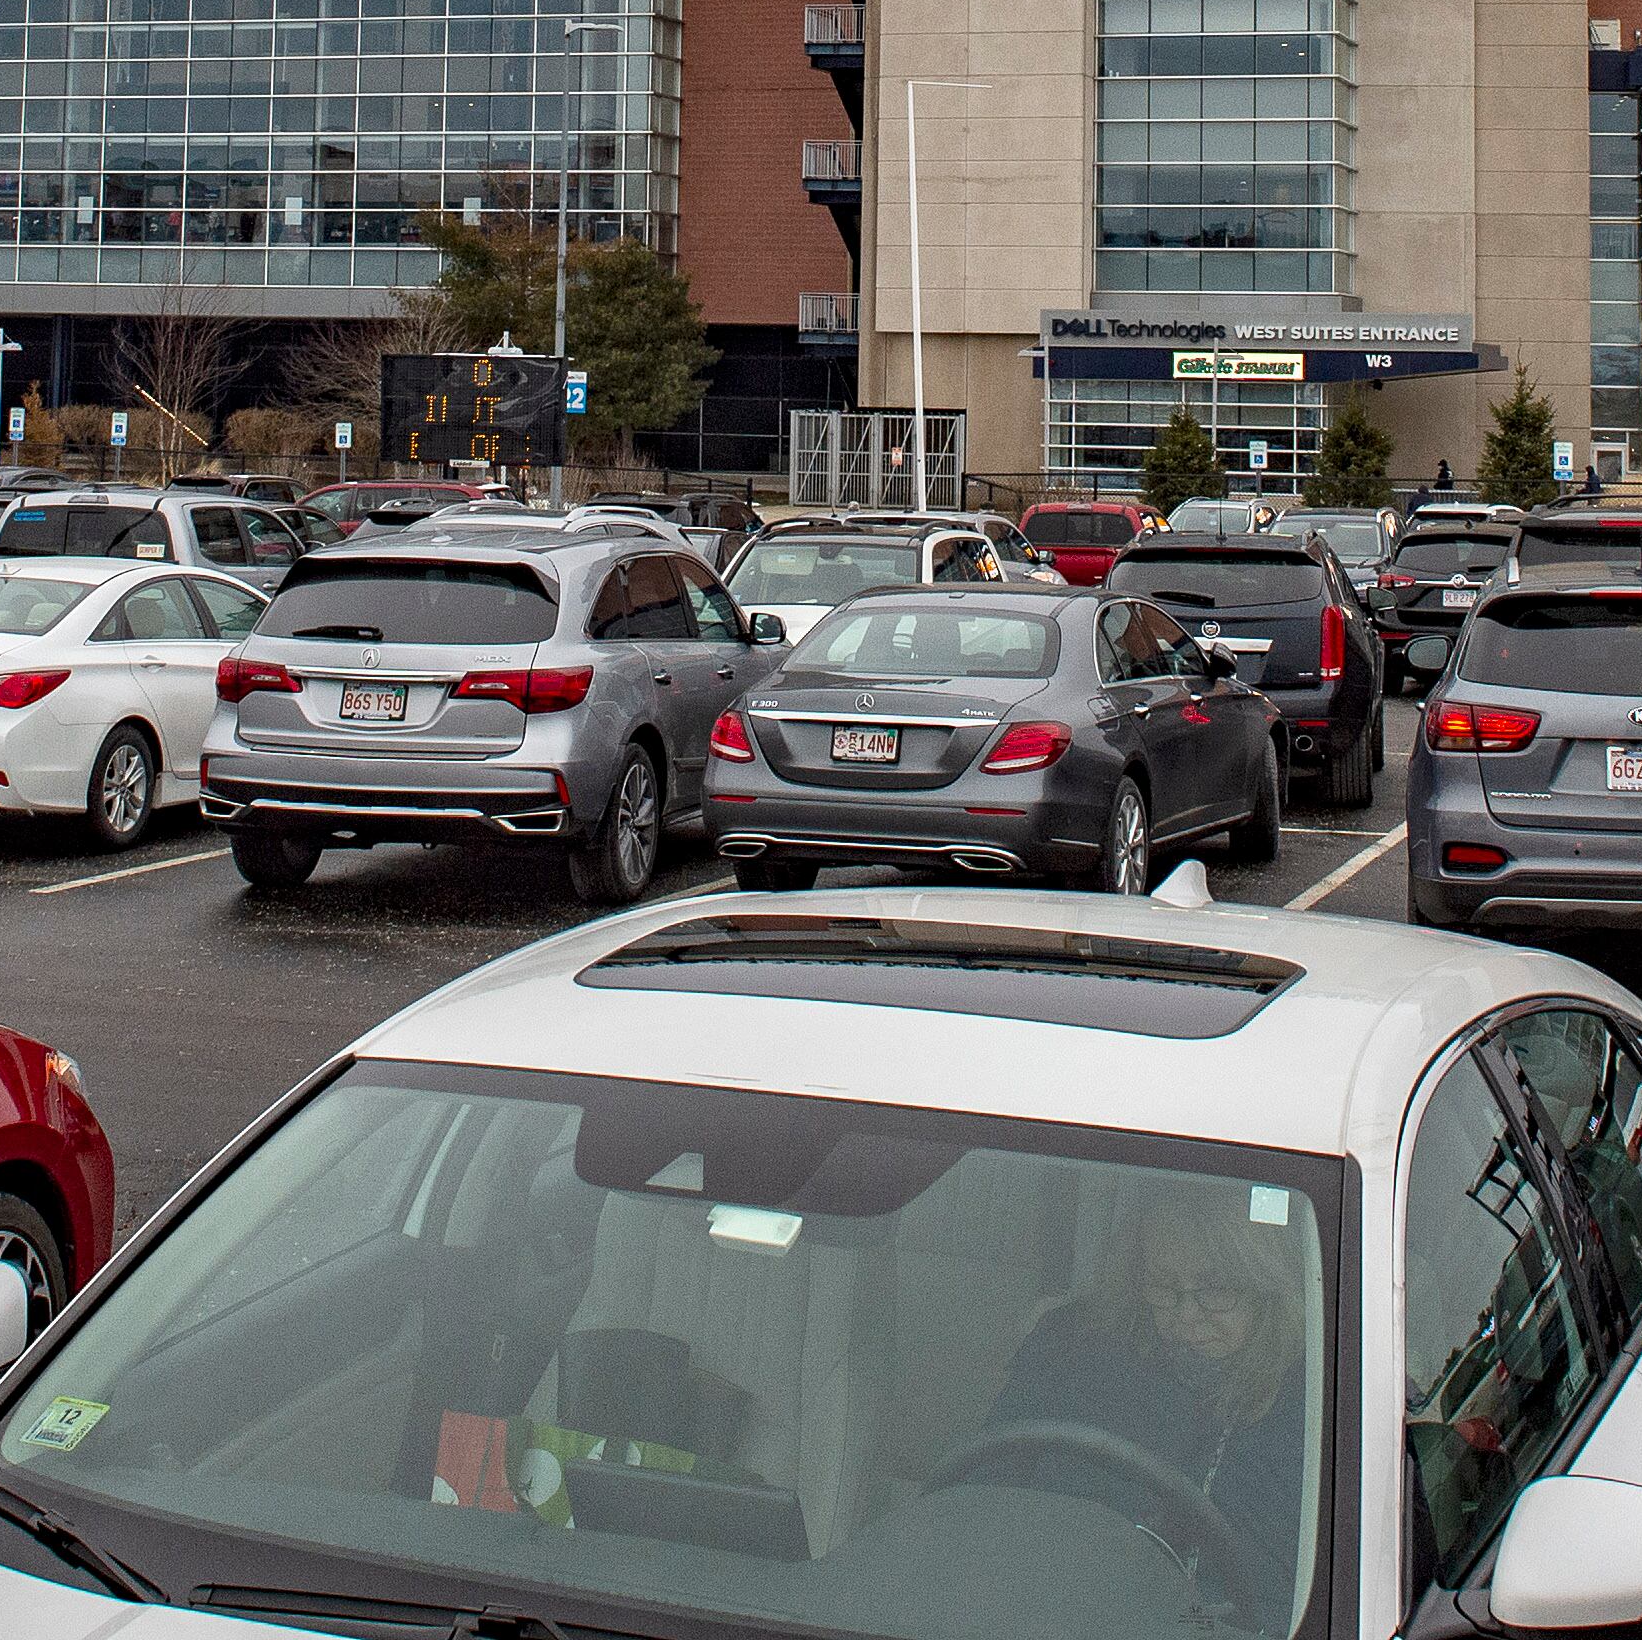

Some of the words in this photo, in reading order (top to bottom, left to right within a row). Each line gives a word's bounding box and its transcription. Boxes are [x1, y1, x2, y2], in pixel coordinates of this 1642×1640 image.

[1051, 318, 1107, 337] DELL
[1107, 318, 1226, 343] Technologies
[1234, 325, 1286, 339] WEST
[1290, 325, 1354, 340] SUITES
[1358, 327, 1459, 342] ENTRANCE
[1365, 354, 1393, 368] W3
[474, 655, 511, 664] MDX
[375, 695, 402, 711] Y50
[759, 700, 779, 708] 300
[59, 1408, 83, 1425] 12
